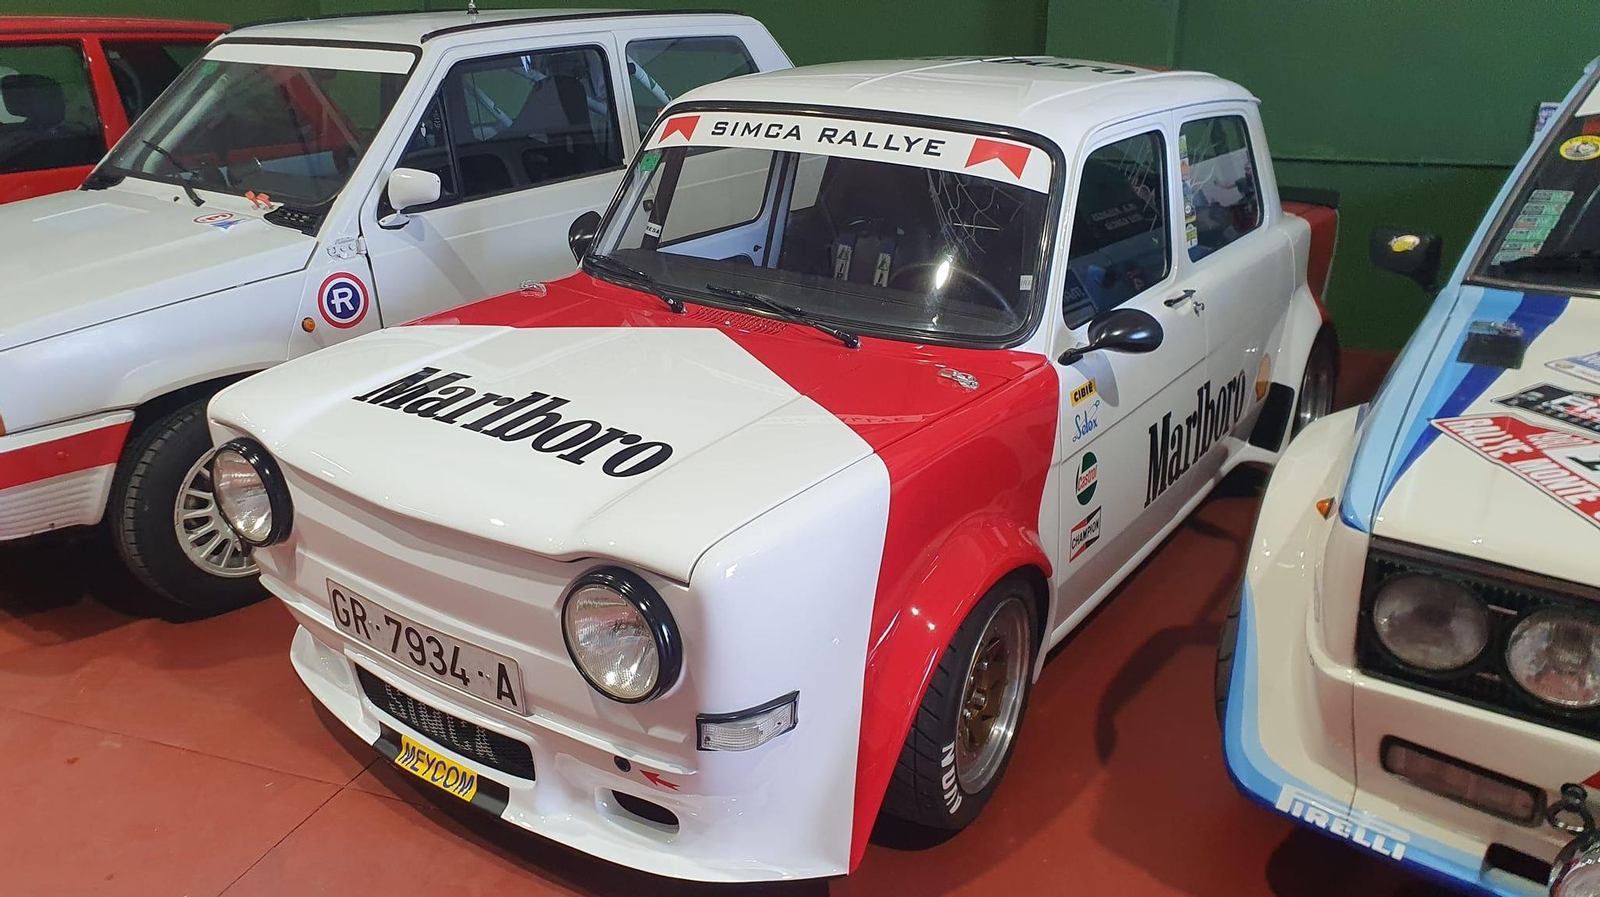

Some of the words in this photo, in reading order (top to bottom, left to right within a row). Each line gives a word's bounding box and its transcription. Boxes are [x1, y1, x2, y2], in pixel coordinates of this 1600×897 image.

[711, 121, 801, 141] SIMCA
[817, 127, 946, 157] RALLYE
[351, 366, 675, 478] Marlboro
[1144, 369, 1247, 508] Marlboro
[1077, 464, 1098, 492] Castrol
[1442, 417, 1533, 459] RALLYE
[1510, 457, 1600, 506] MONTE
[1071, 518, 1100, 550] CHAMPION
[398, 742, 476, 799] MEYCOM
[1275, 783, 1411, 862] PIRELLI
